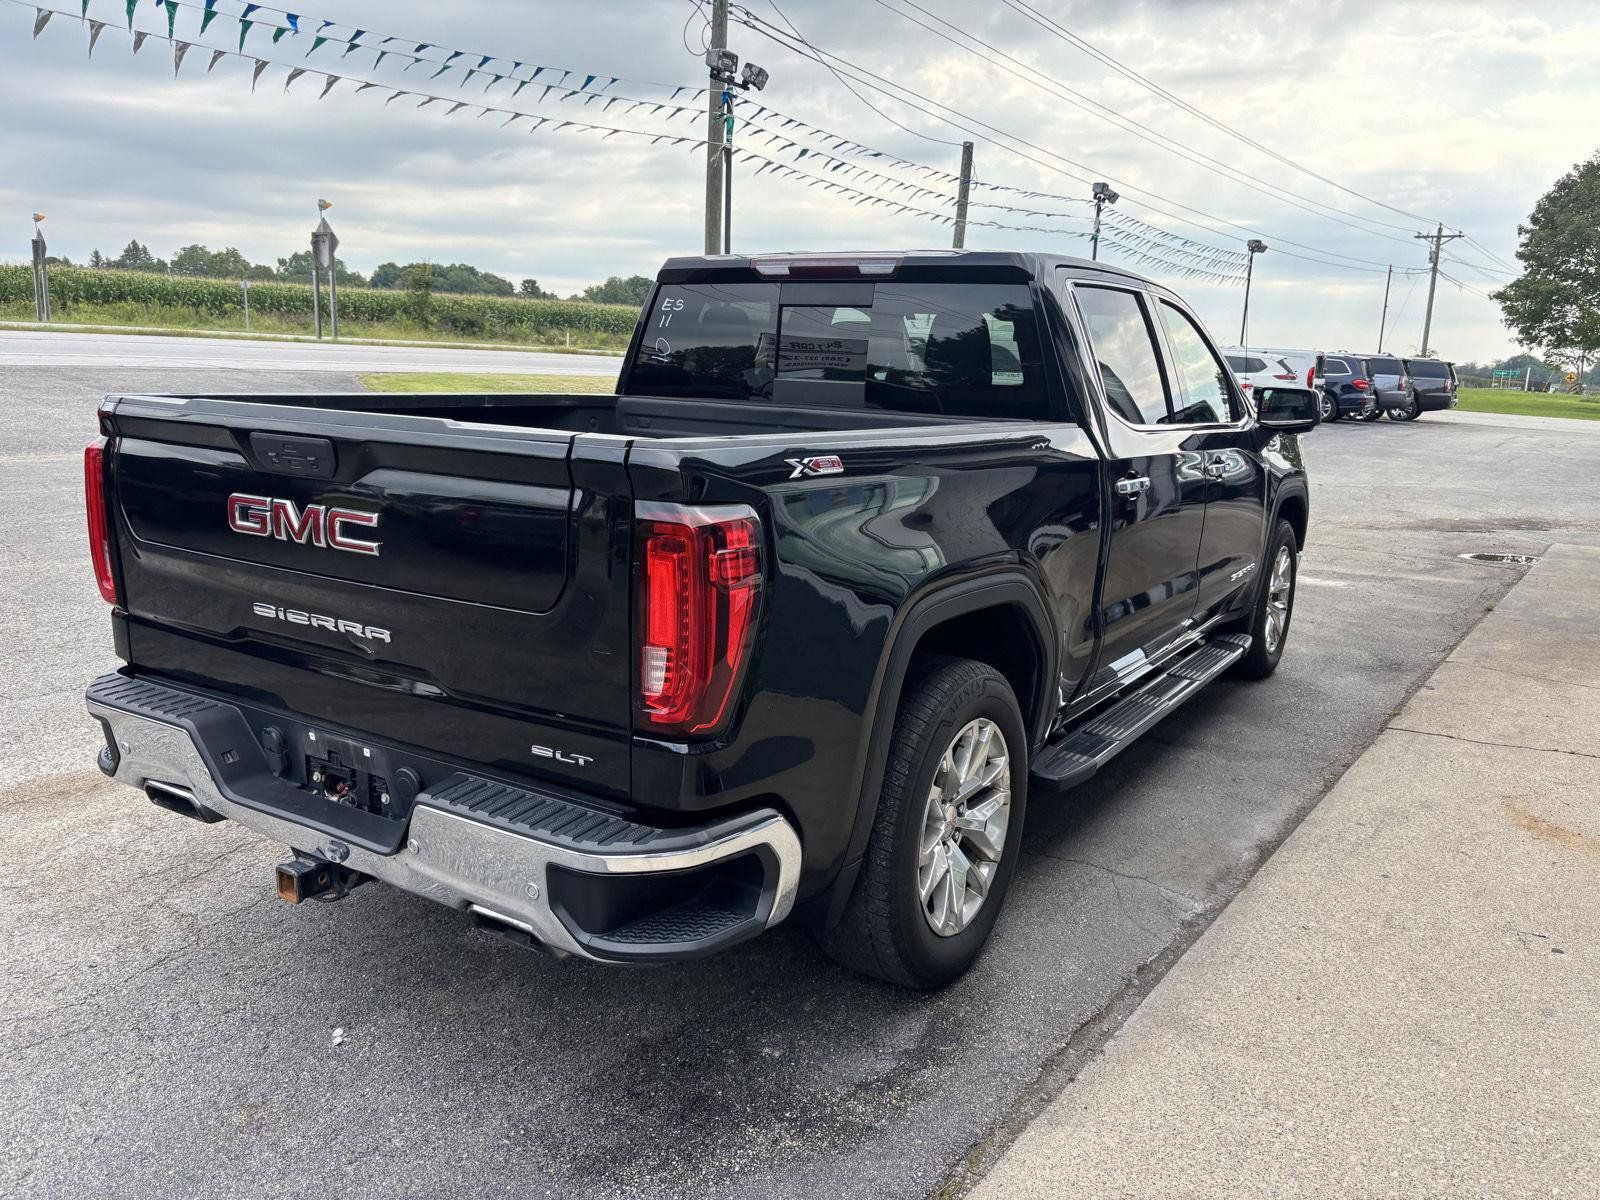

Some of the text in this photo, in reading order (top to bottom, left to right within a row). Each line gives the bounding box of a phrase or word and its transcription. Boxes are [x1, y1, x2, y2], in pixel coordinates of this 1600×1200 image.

[228, 492, 379, 556] GMC
[253, 602, 391, 643] SIERRA
[531, 744, 594, 766] SLT
